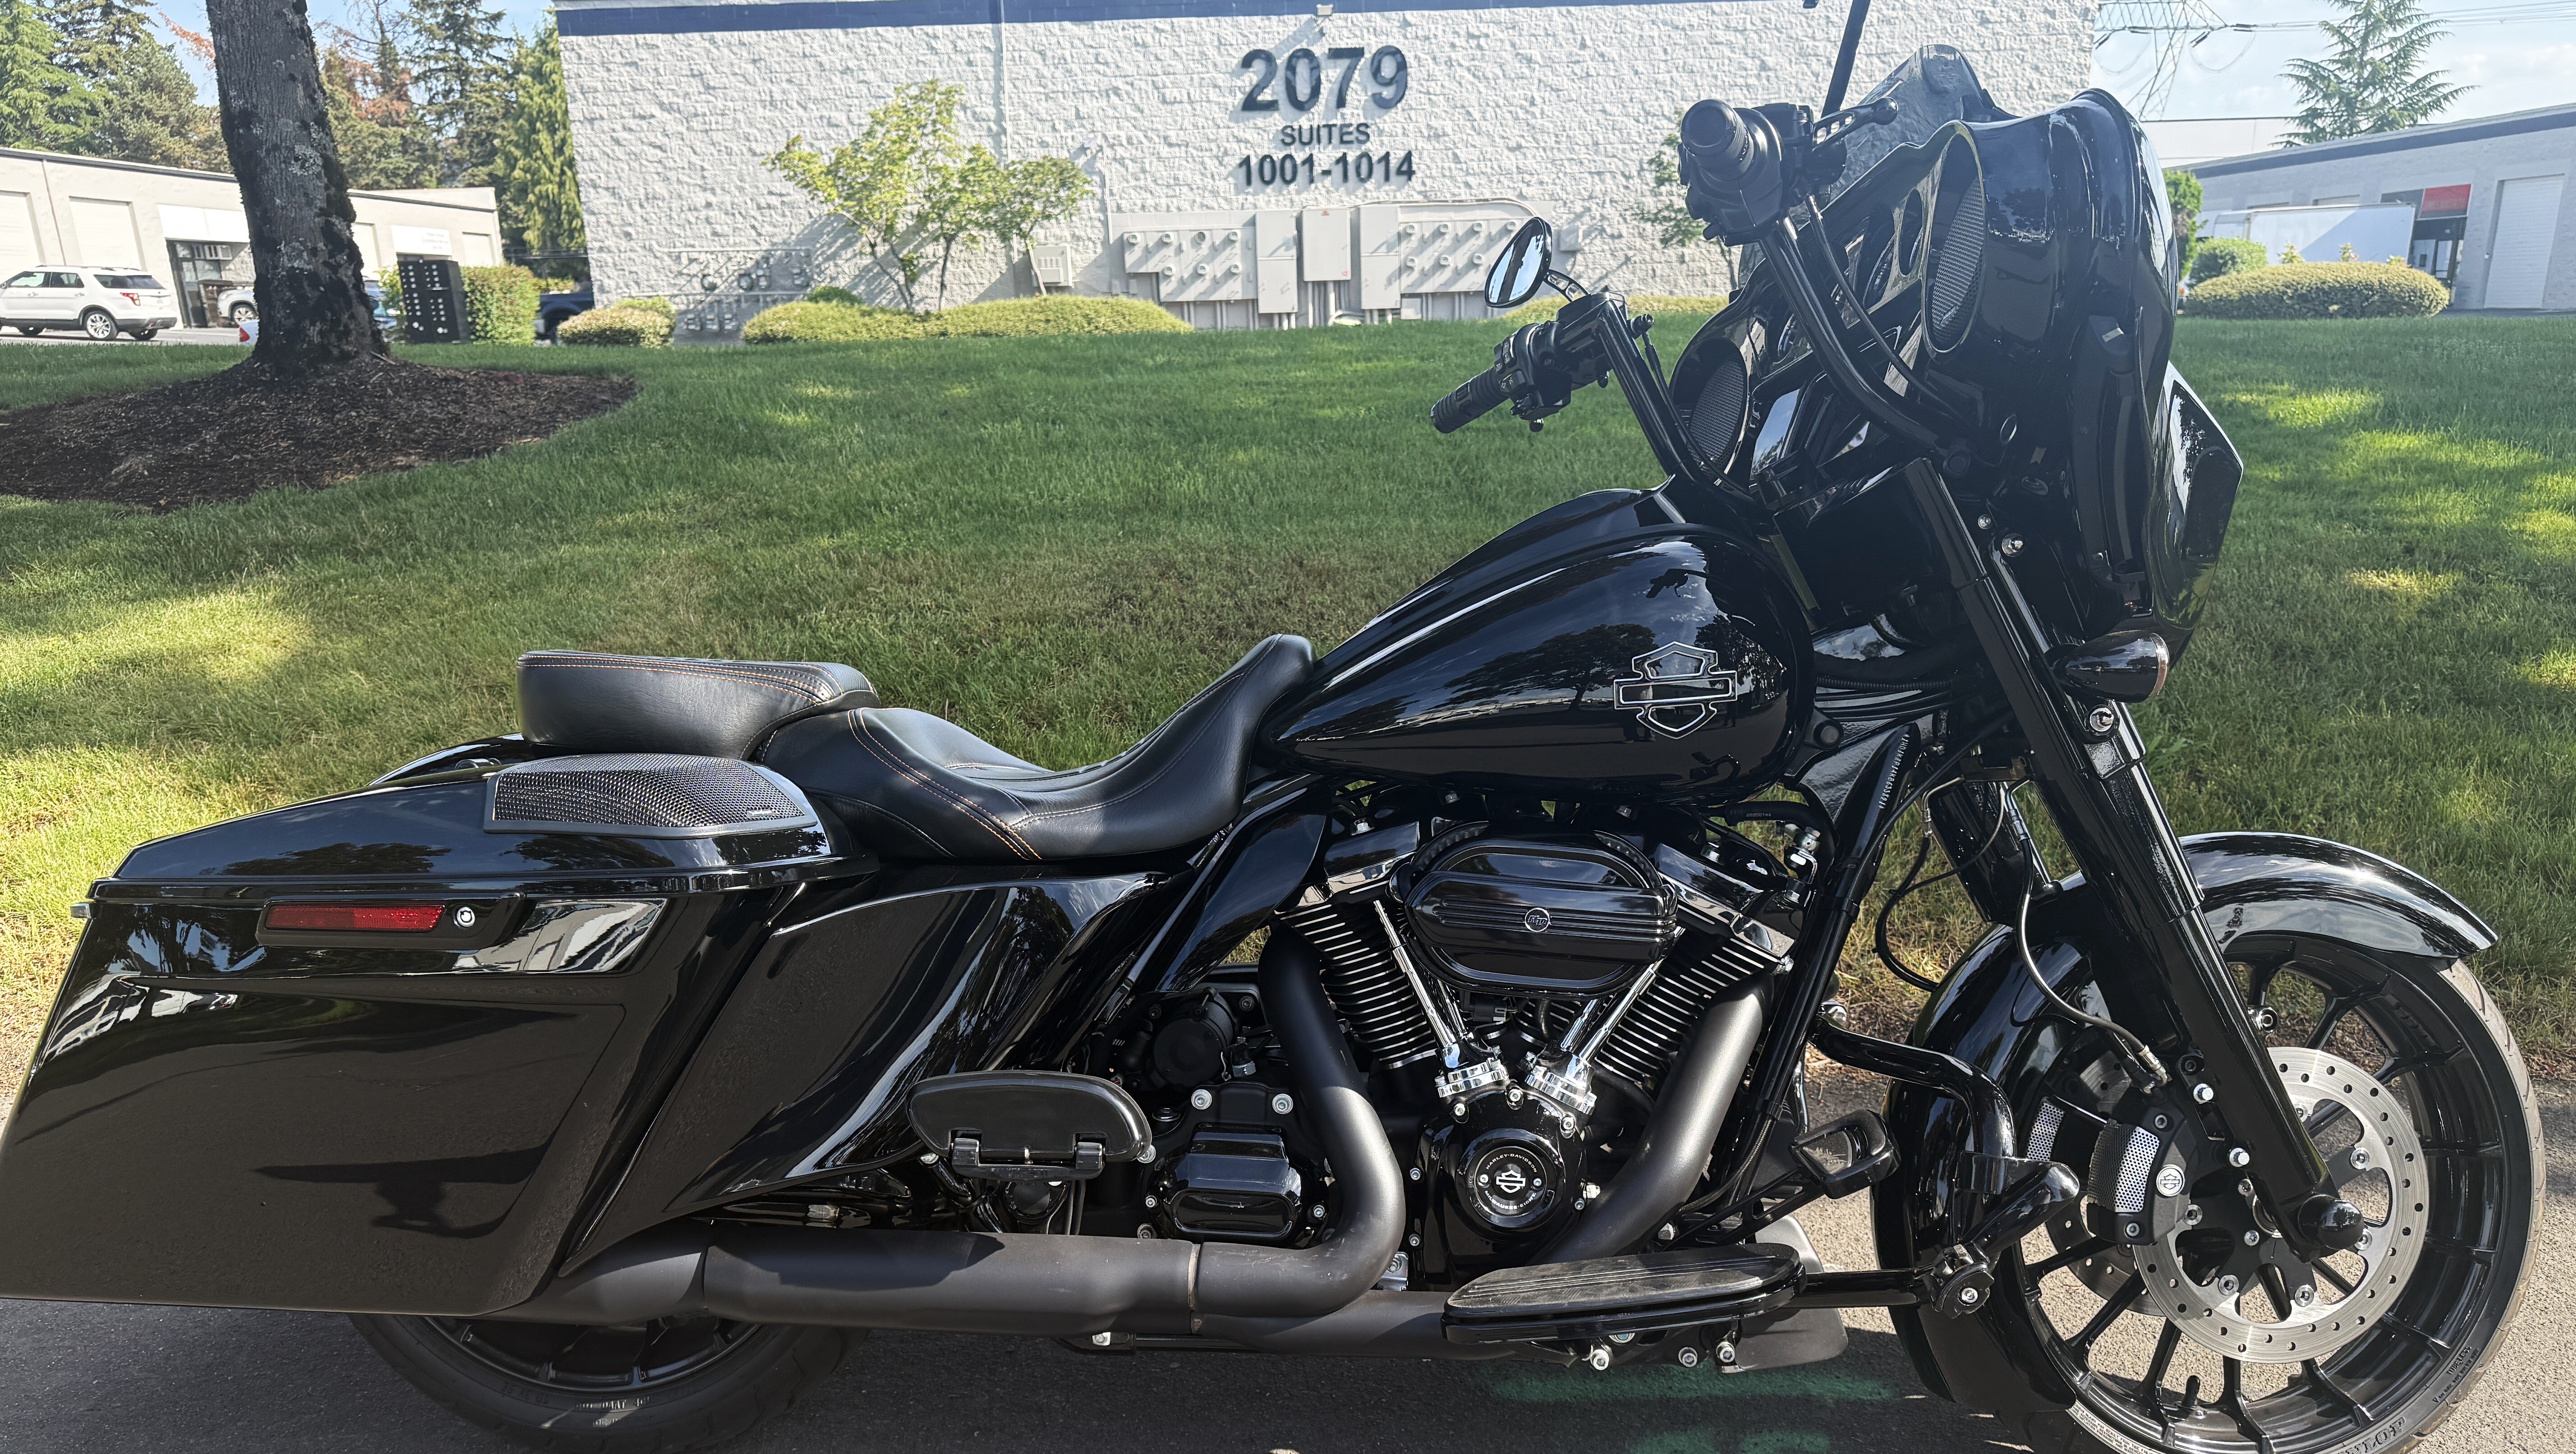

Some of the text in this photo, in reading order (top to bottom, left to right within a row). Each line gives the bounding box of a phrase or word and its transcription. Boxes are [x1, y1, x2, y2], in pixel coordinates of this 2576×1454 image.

[1241, 45, 1408, 111] 2079
[1280, 123, 1371, 146] SUITES
[1238, 150, 1416, 186] 1001-1014
[1486, 1153, 1537, 1172] HARLEY-DAVIDSON
